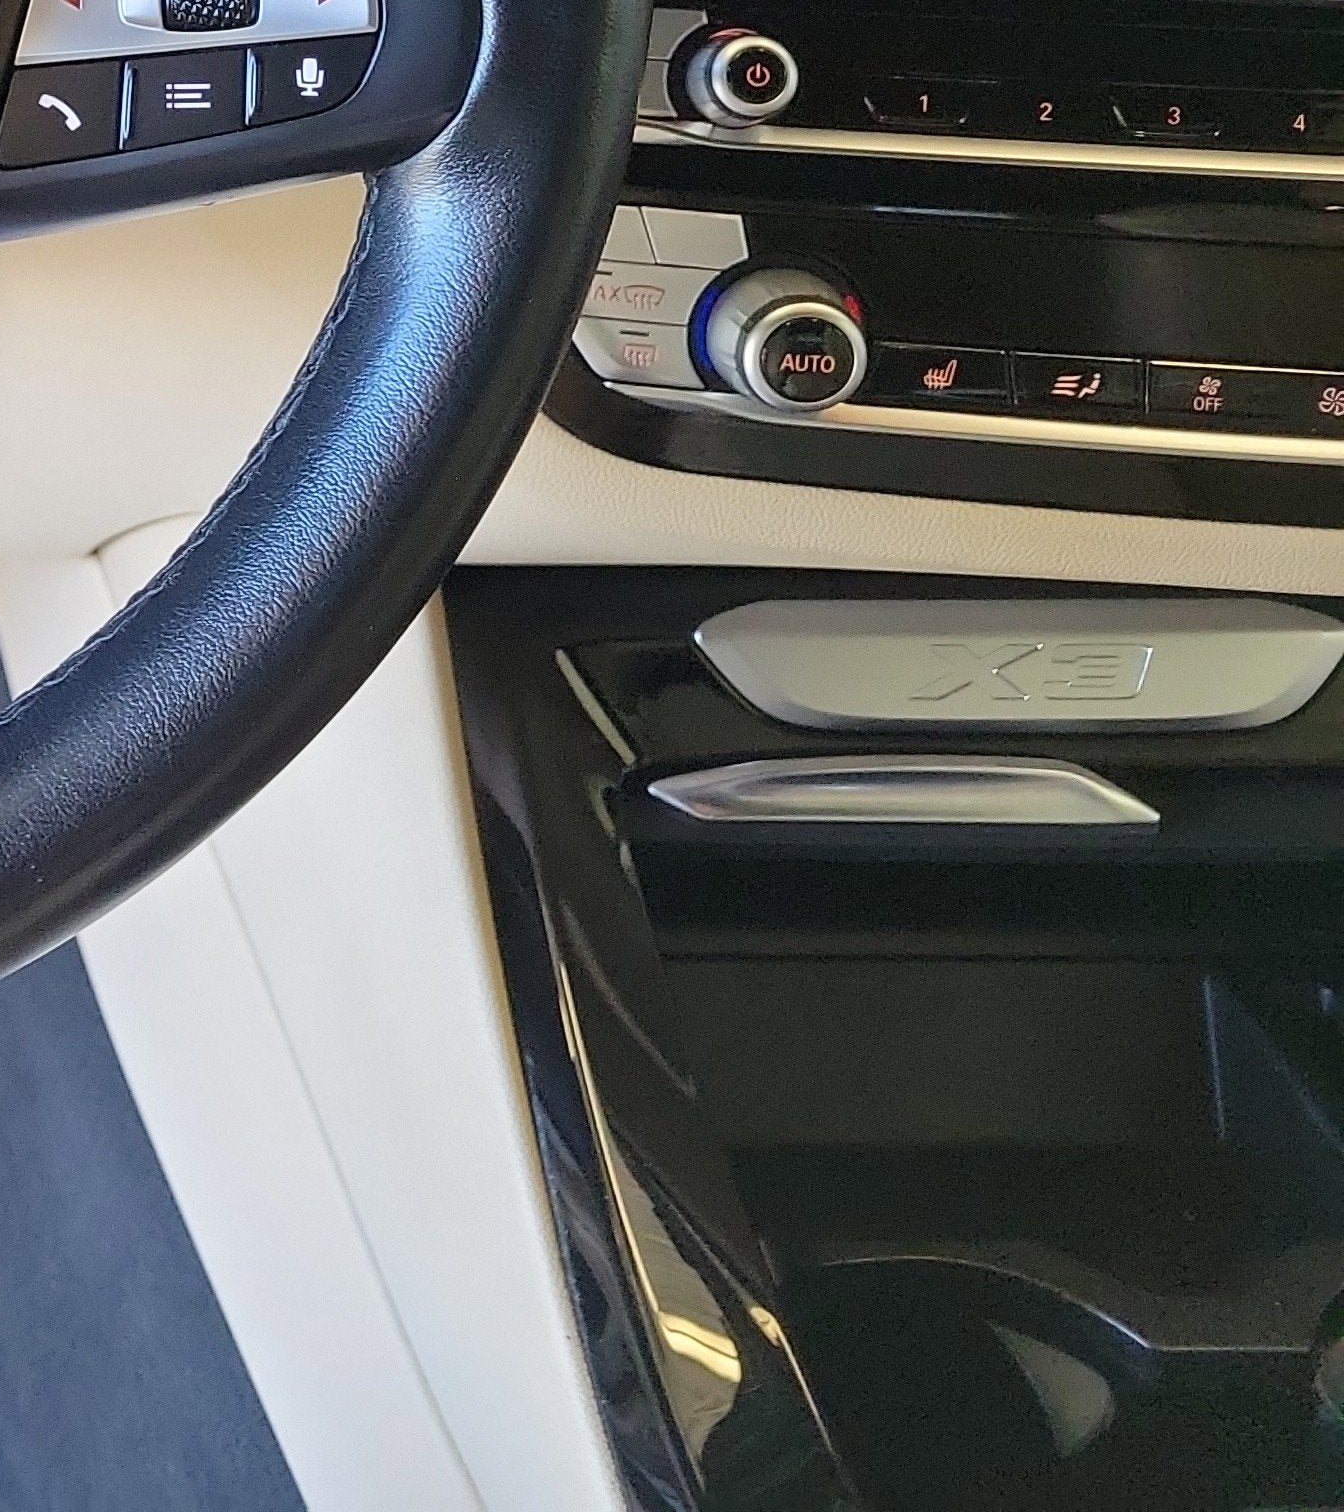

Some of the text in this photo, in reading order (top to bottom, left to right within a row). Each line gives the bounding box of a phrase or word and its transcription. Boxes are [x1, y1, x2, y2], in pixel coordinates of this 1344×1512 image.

[918, 95, 1306, 133] 1 2 3 4
[779, 353, 836, 376] AUTO
[1193, 396, 1224, 412] OFF
[908, 642, 1154, 701] X3
